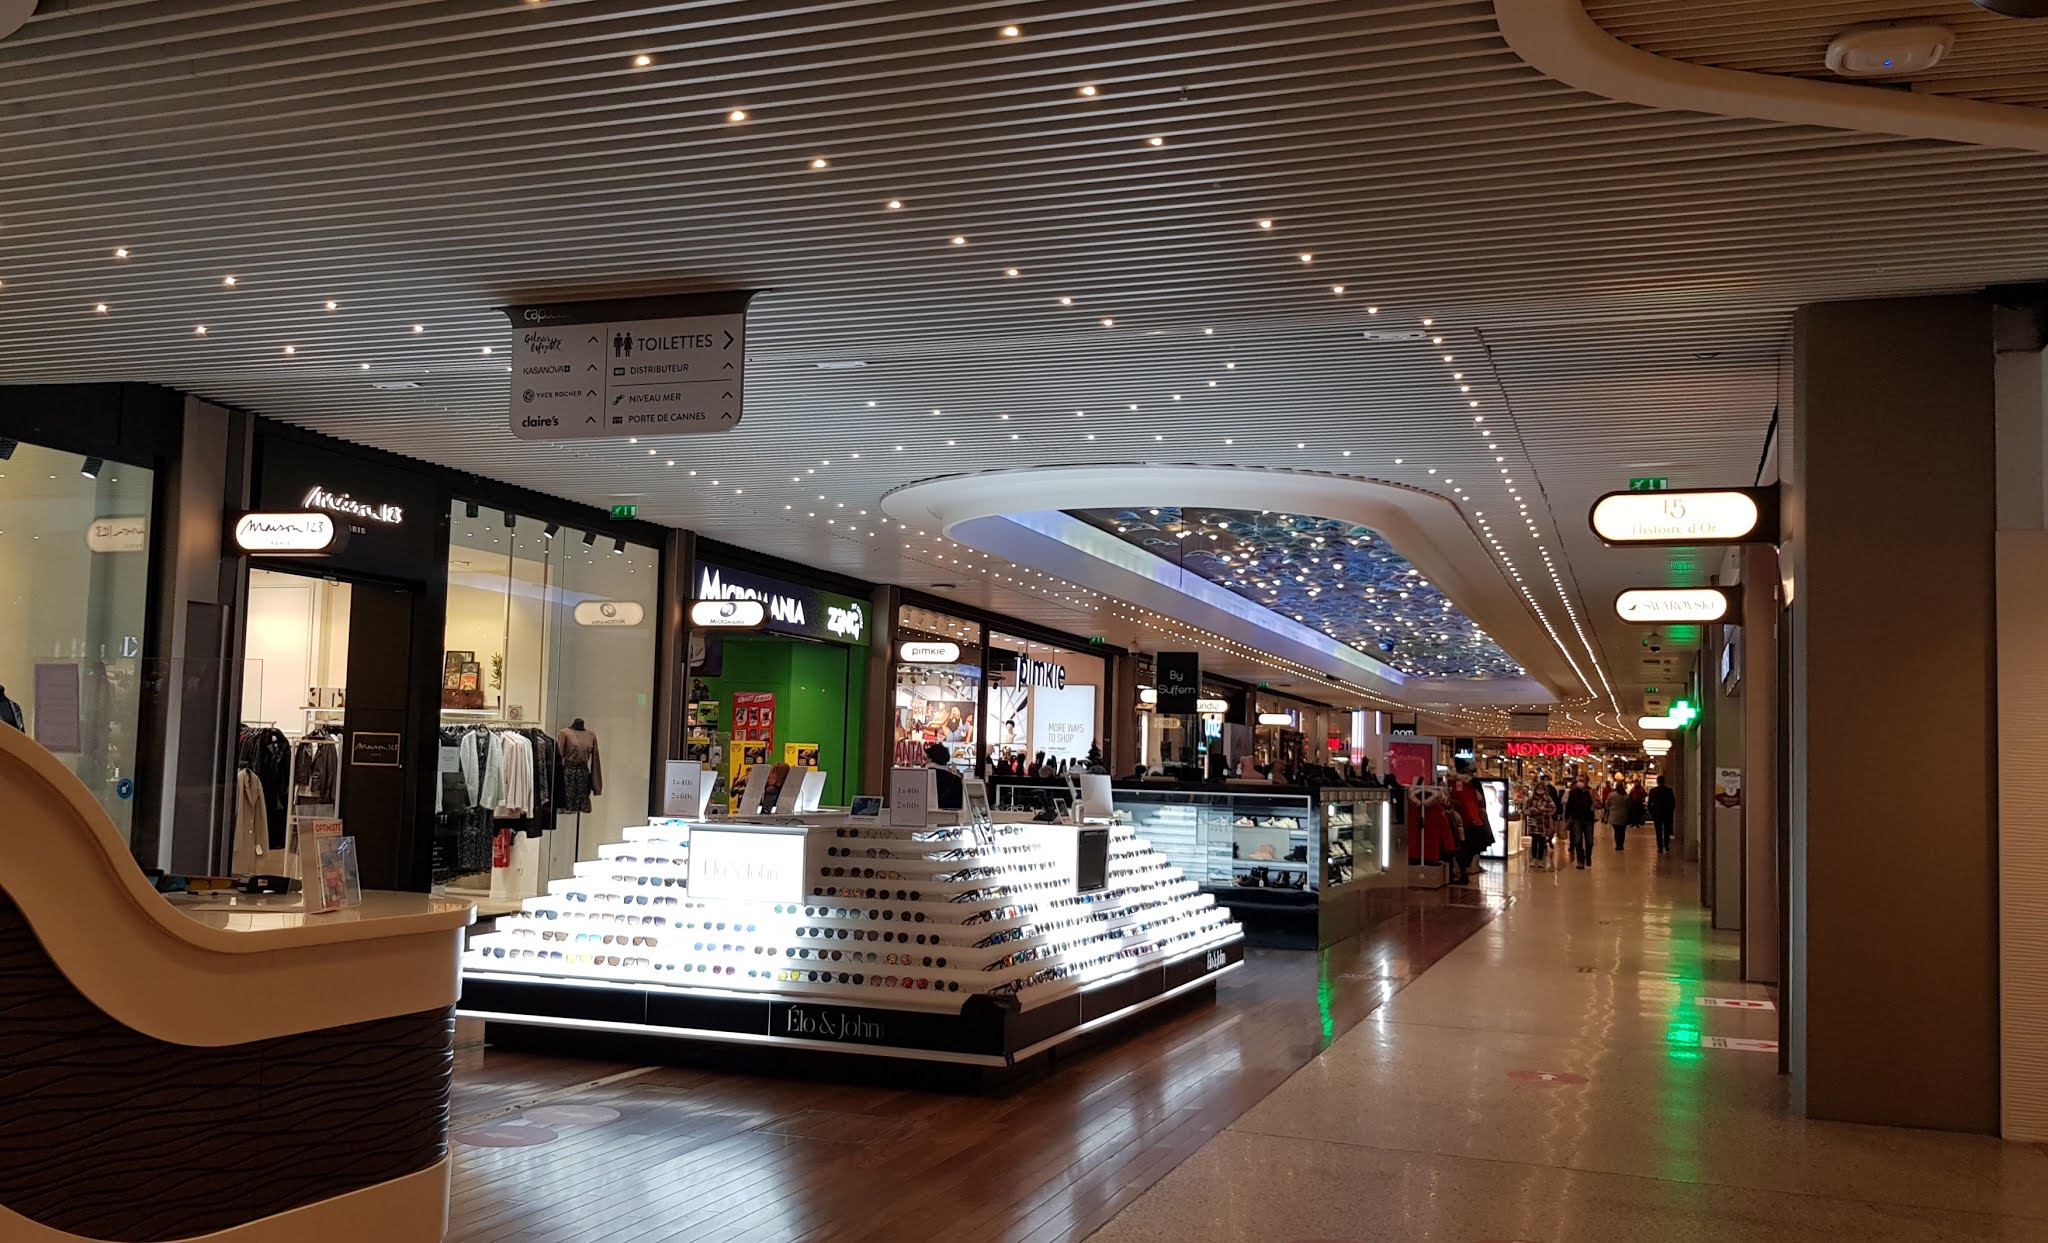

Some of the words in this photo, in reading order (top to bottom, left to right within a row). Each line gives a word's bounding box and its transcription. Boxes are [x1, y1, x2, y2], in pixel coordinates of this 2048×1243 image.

[637, 333, 713, 352] TOILETTES
[630, 363, 689, 375] DISTRIBUTEUR
[536, 390, 553, 399] YVES
[554, 389, 582, 398] ROCHER
[629, 393, 662, 404] NIVEAU
[663, 392, 682, 402] MER
[522, 415, 559, 428] claire's
[628, 413, 655, 424] PORTE
[657, 413, 669, 422] DE
[670, 411, 706, 422] CANNES
[240, 519, 304, 535] Maison
[306, 521, 324, 533] 123
[1642, 599, 1715, 611] SWAROVSKI
[911, 647, 946, 657] pimkie
[1014, 656, 1066, 692] pimkie
[1169, 669, 1184, 682] By
[1158, 684, 1196, 696] Suffern
[1048, 722, 1066, 733] MORE
[1067, 723, 1085, 733] WAYS
[1048, 733, 1056, 742] TO
[1506, 742, 1592, 756] MONOPRIX
[786, 1004, 816, 1033] Élo
[819, 1010, 836, 1035] &
[838, 1013, 880, 1040] John
